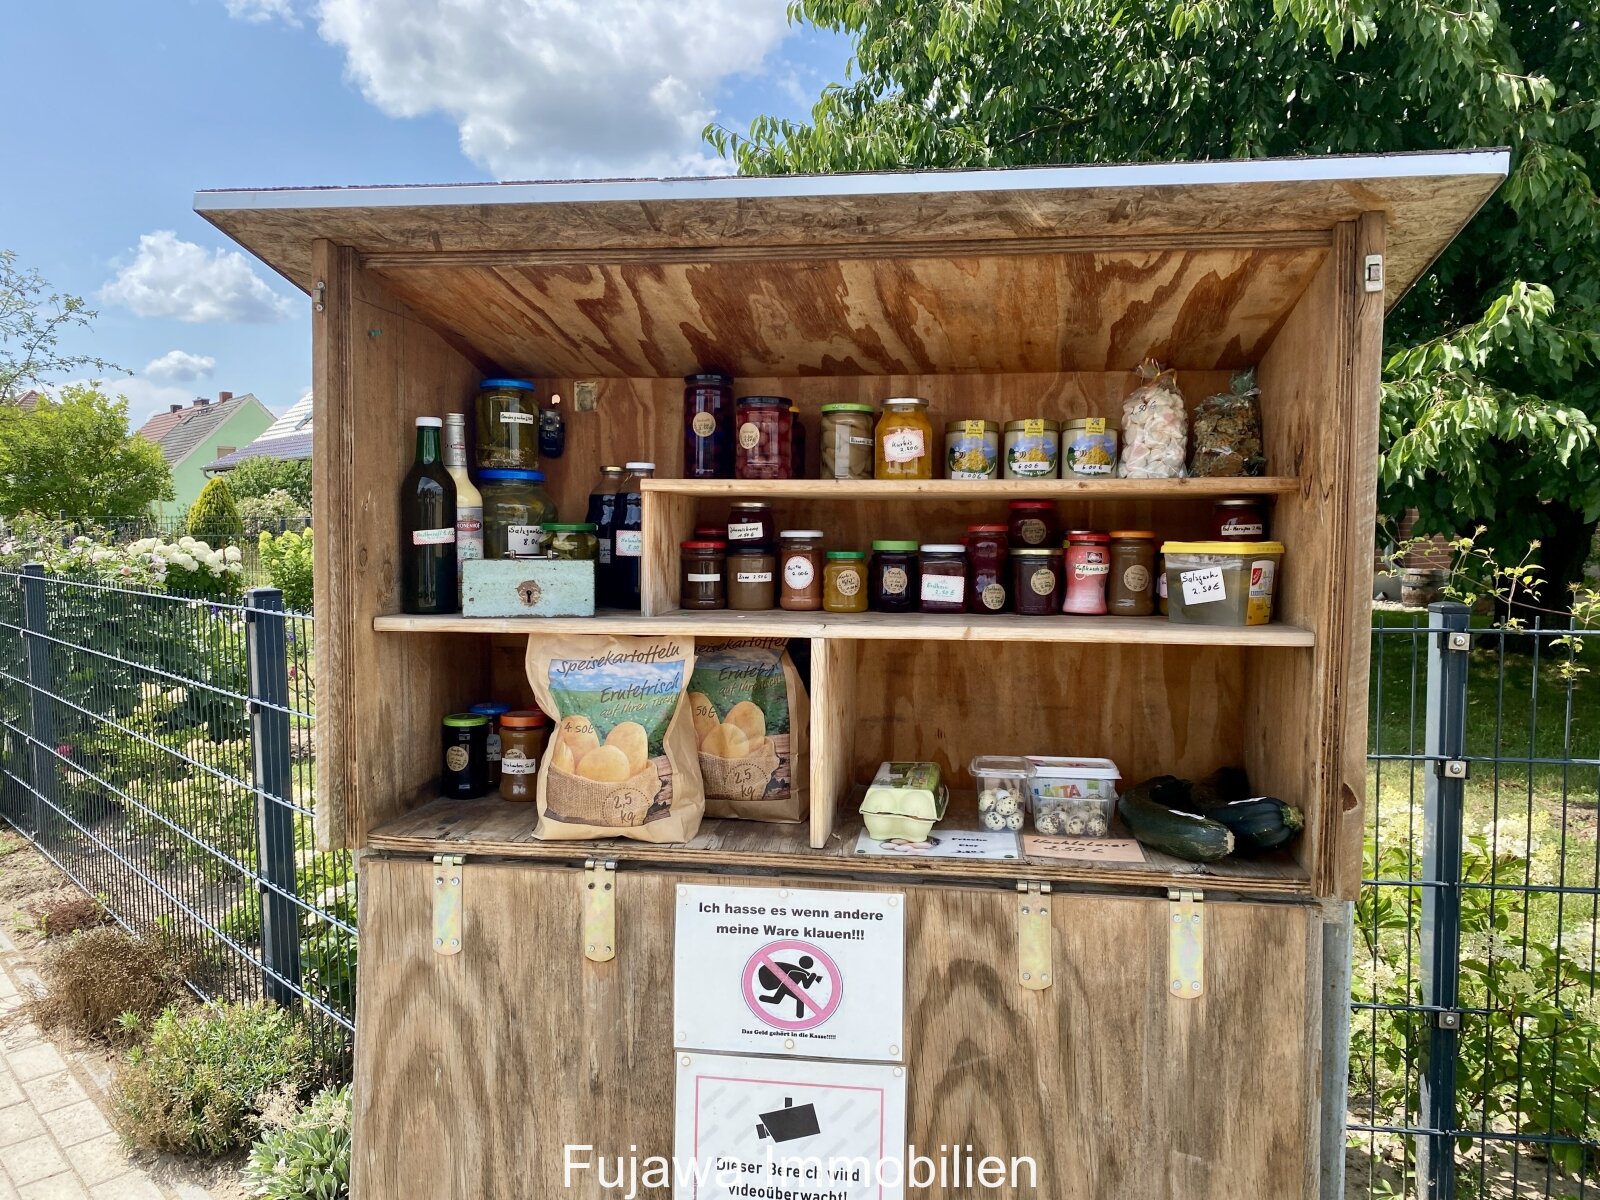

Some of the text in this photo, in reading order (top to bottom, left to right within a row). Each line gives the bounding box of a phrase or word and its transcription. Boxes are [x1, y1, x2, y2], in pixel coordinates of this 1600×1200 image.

[1192, 584, 1220, 595] 2.50€
[557, 642, 680, 677] Speisekartoffeln
[600, 672, 680, 703] Erntefrisch
[600, 703, 619, 717] auf
[734, 768, 751, 784] 2,5
[613, 792, 632, 809] 2,5
[741, 785, 756, 800] kg
[621, 810, 636, 827] kg
[699, 902, 884, 921] Ich hasse es wenn andere
[716, 923, 865, 940] meine Ware klauen!!!
[769, 1029, 790, 1037] gehört
